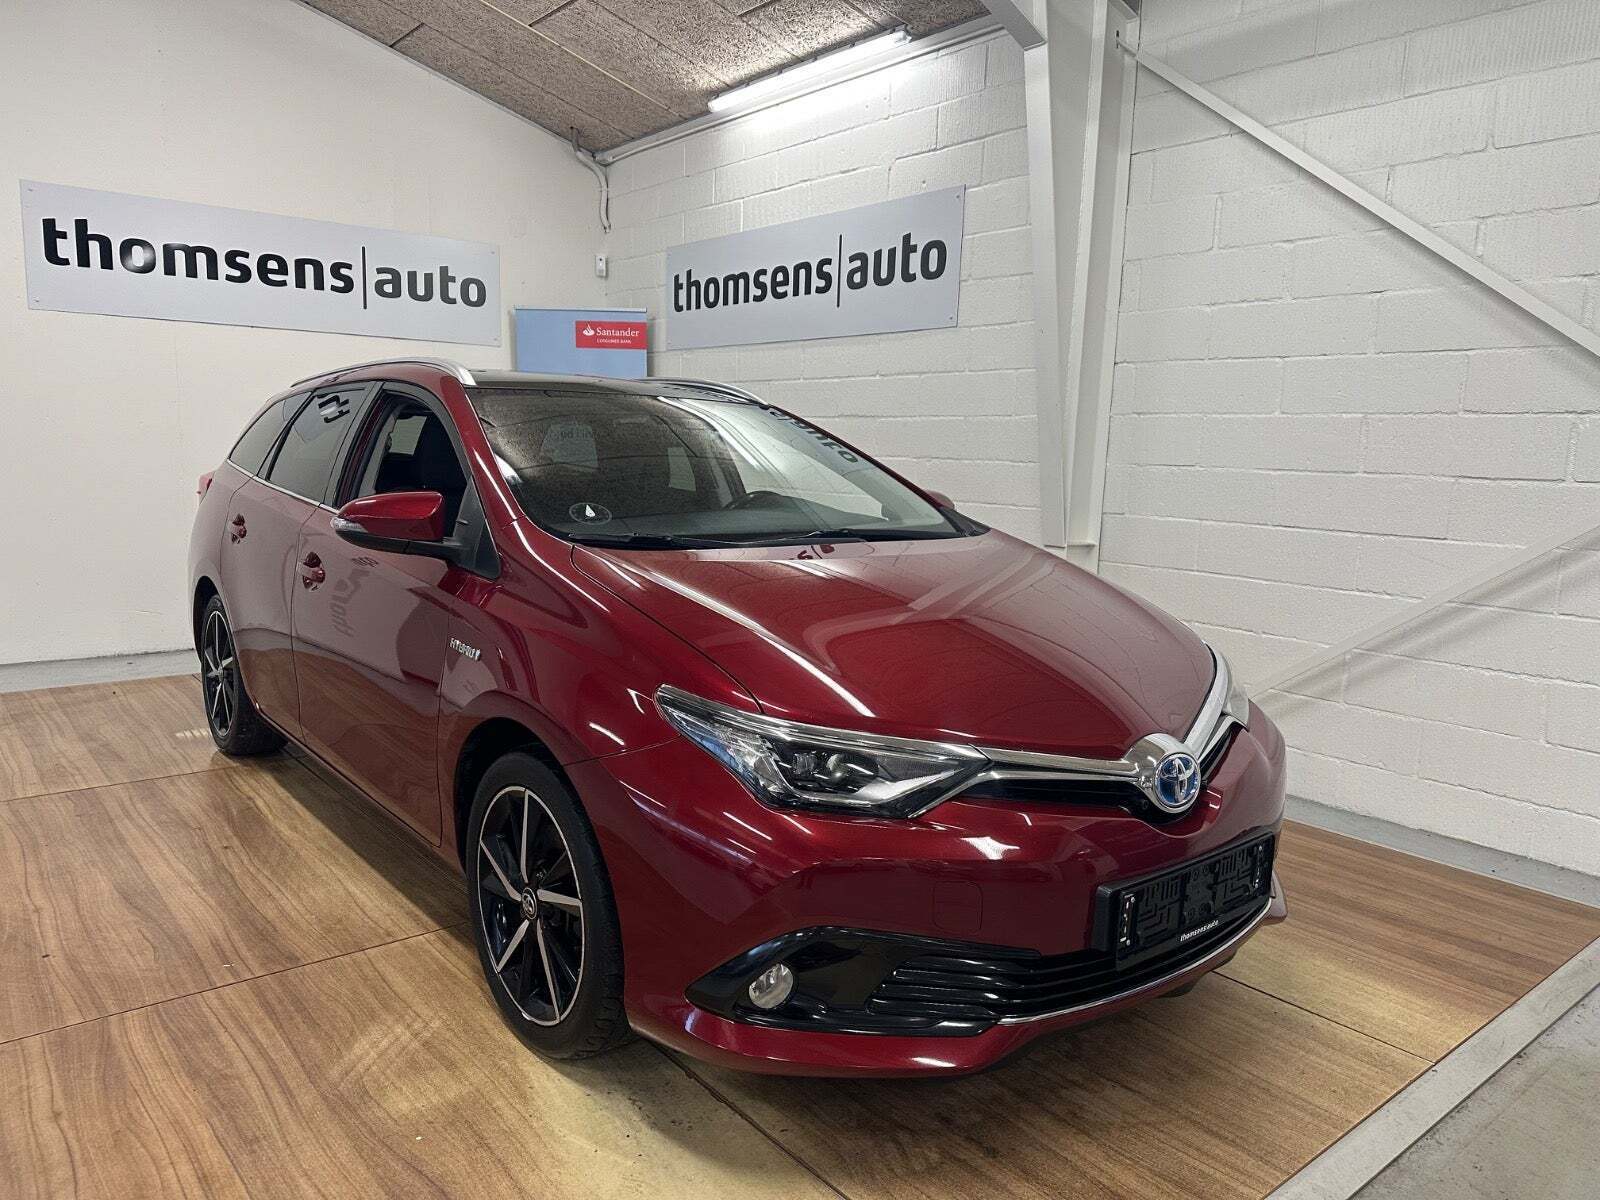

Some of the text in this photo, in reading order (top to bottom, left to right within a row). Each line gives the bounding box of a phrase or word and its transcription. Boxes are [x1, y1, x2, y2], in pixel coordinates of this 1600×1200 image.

[42, 218, 487, 307] thomsens auto
[673, 232, 947, 312] thomsens auto
[596, 327, 640, 337] Santander
